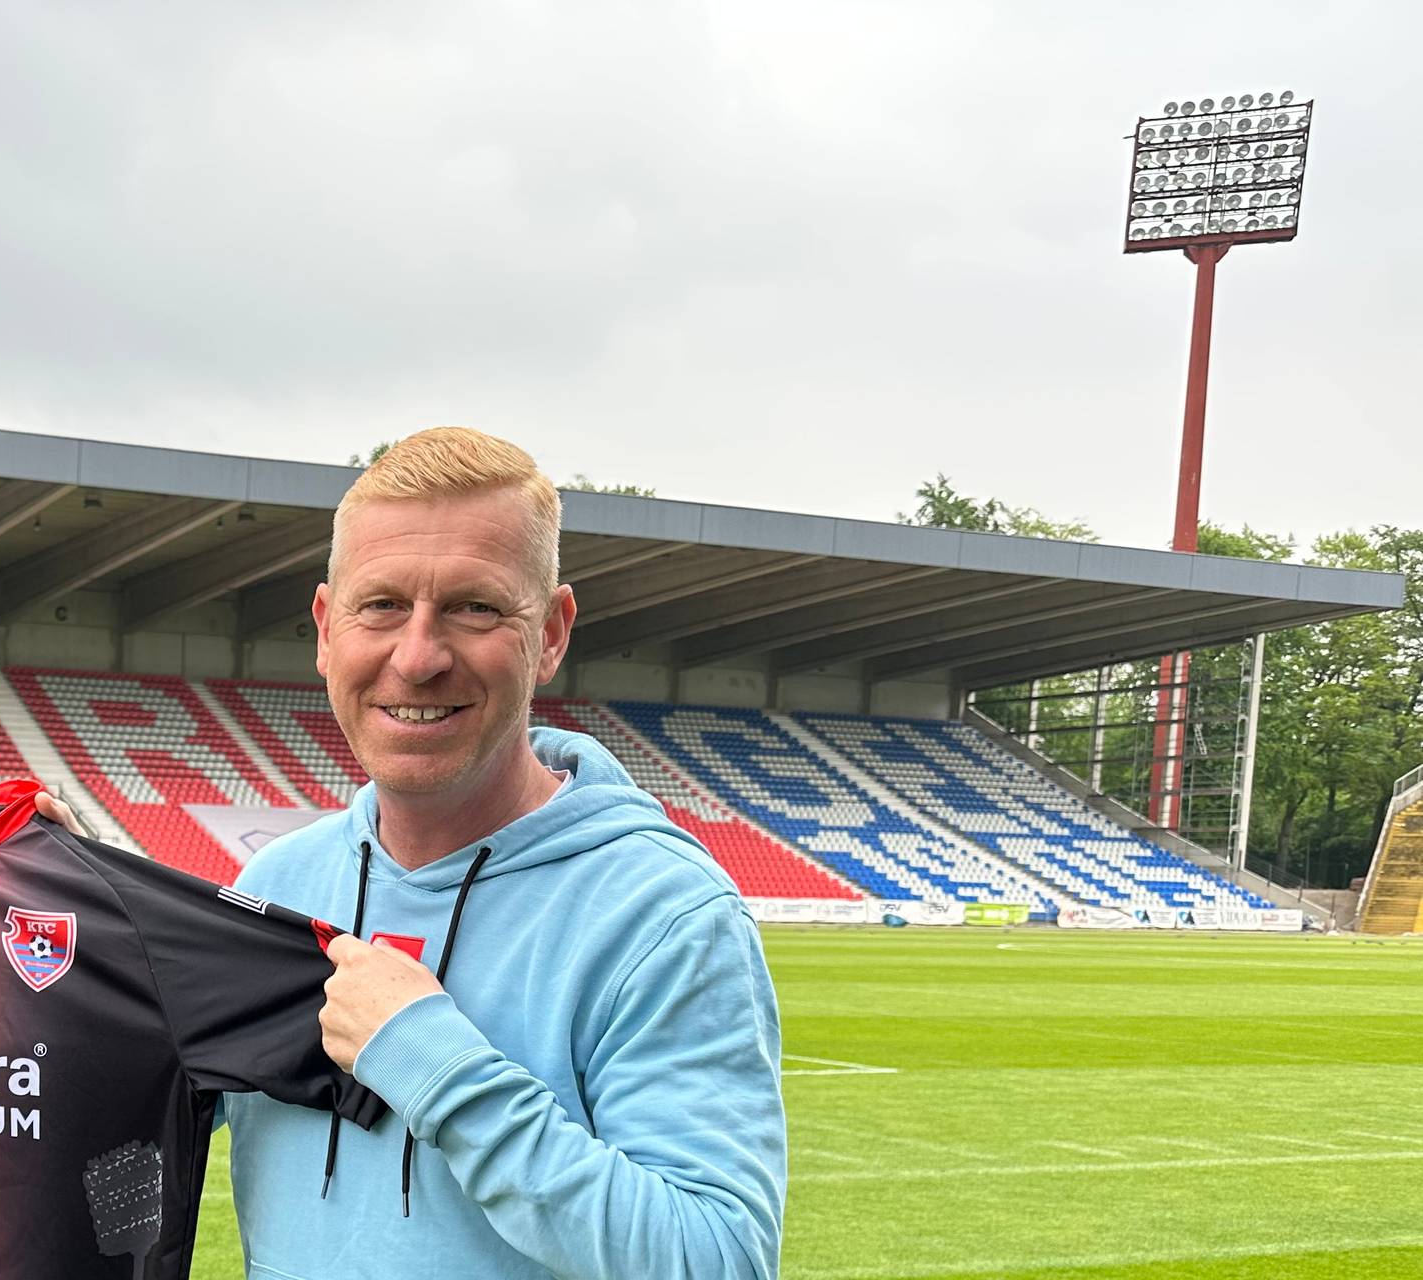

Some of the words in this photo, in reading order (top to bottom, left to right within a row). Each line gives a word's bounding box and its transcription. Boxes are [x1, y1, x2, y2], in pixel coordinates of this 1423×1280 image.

[54, 606, 68, 622] C
[296, 623, 308, 638] C
[26, 920, 57, 934] KFC
